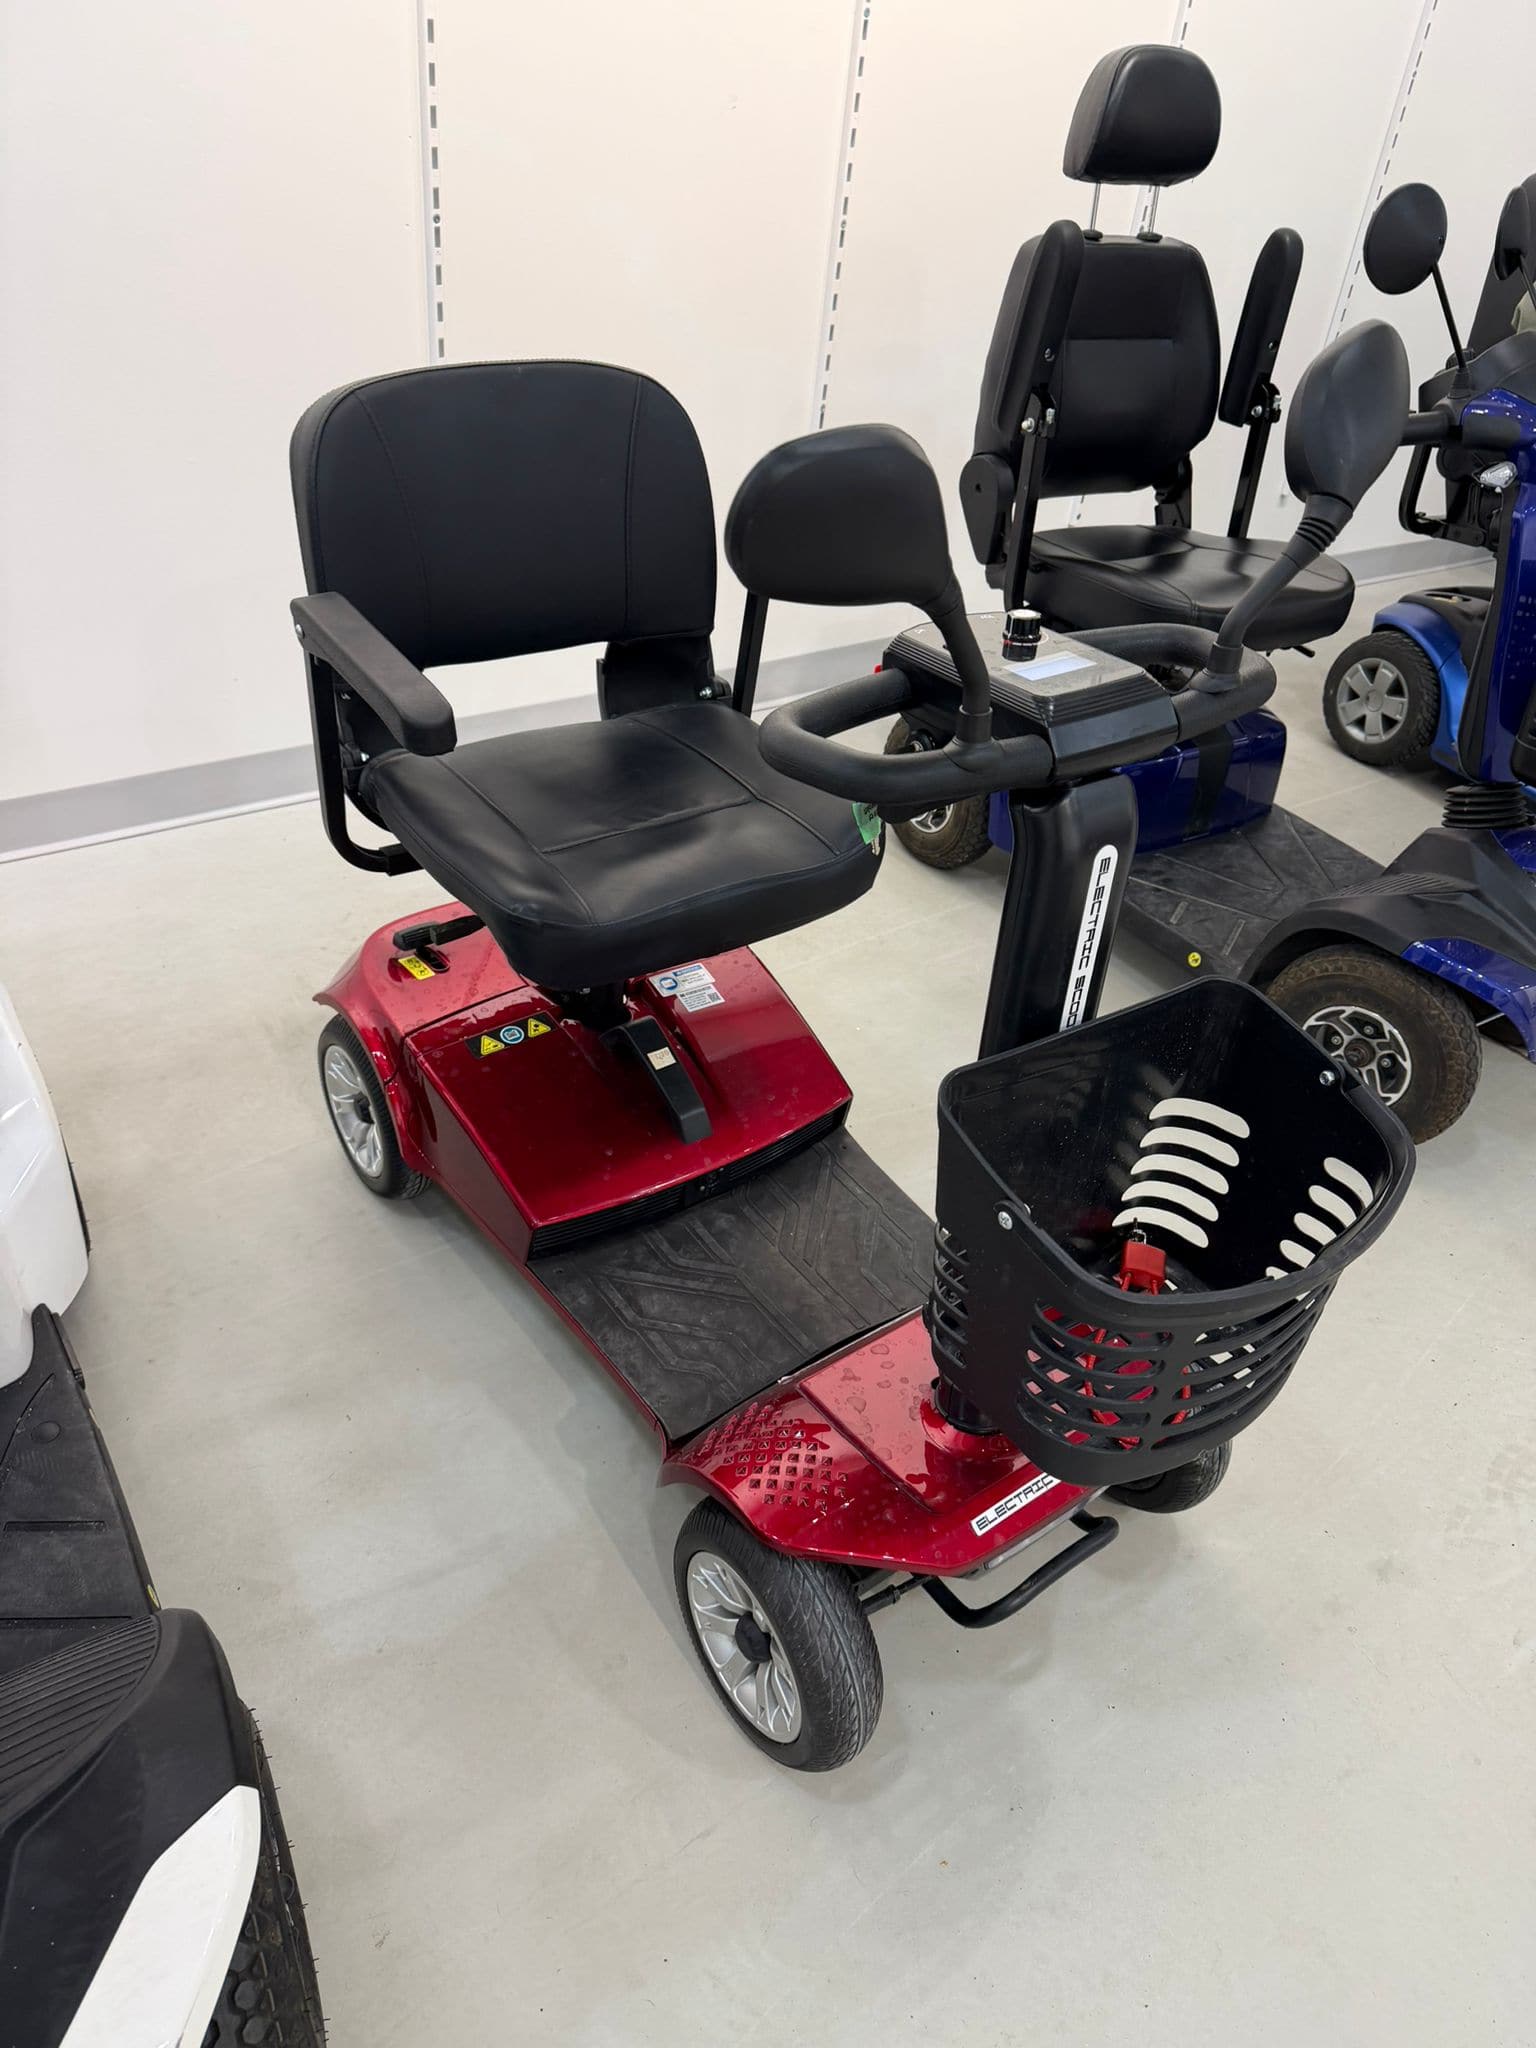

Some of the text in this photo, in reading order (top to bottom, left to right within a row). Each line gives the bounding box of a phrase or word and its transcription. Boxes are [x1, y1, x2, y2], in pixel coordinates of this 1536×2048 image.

[1065, 856, 1112, 1029] ELECTRIC SCOO
[975, 1473, 1054, 1531] ELECTRIC
